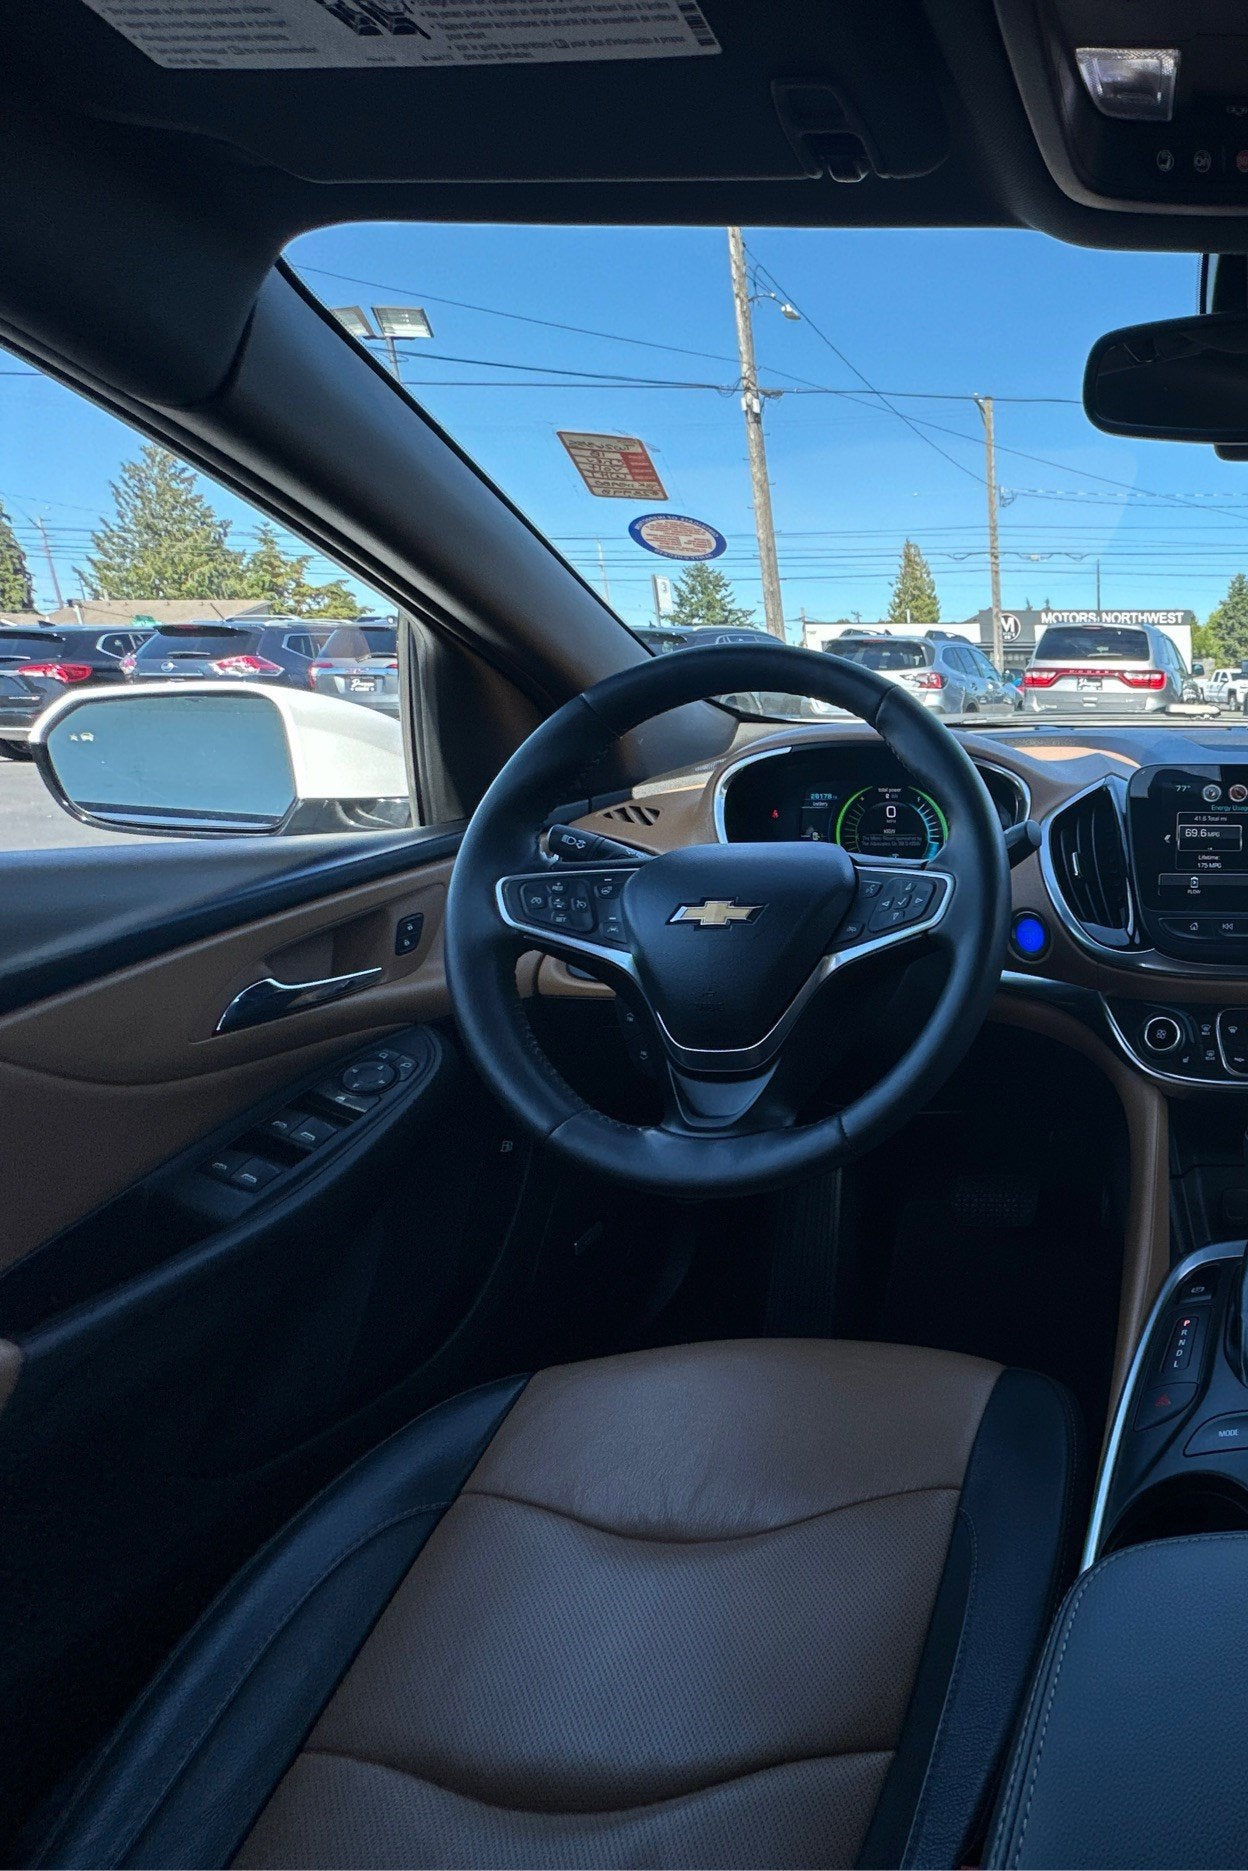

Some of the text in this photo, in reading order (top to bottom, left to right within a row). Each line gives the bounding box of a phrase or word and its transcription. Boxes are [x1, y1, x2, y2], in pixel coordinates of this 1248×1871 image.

[1041, 611, 1185, 624] MOTORS NORTHWEST
[885, 805, 897, 819] 0
[1211, 804, 1231, 812] Energy
[1185, 828, 1208, 838] 69.6
[1183, 1319, 1191, 1327] P
[1178, 1338, 1186, 1346] N
[1175, 1349, 1183, 1357] D
[1172, 1360, 1179, 1368] L
[1218, 1428, 1239, 1437] MODE
